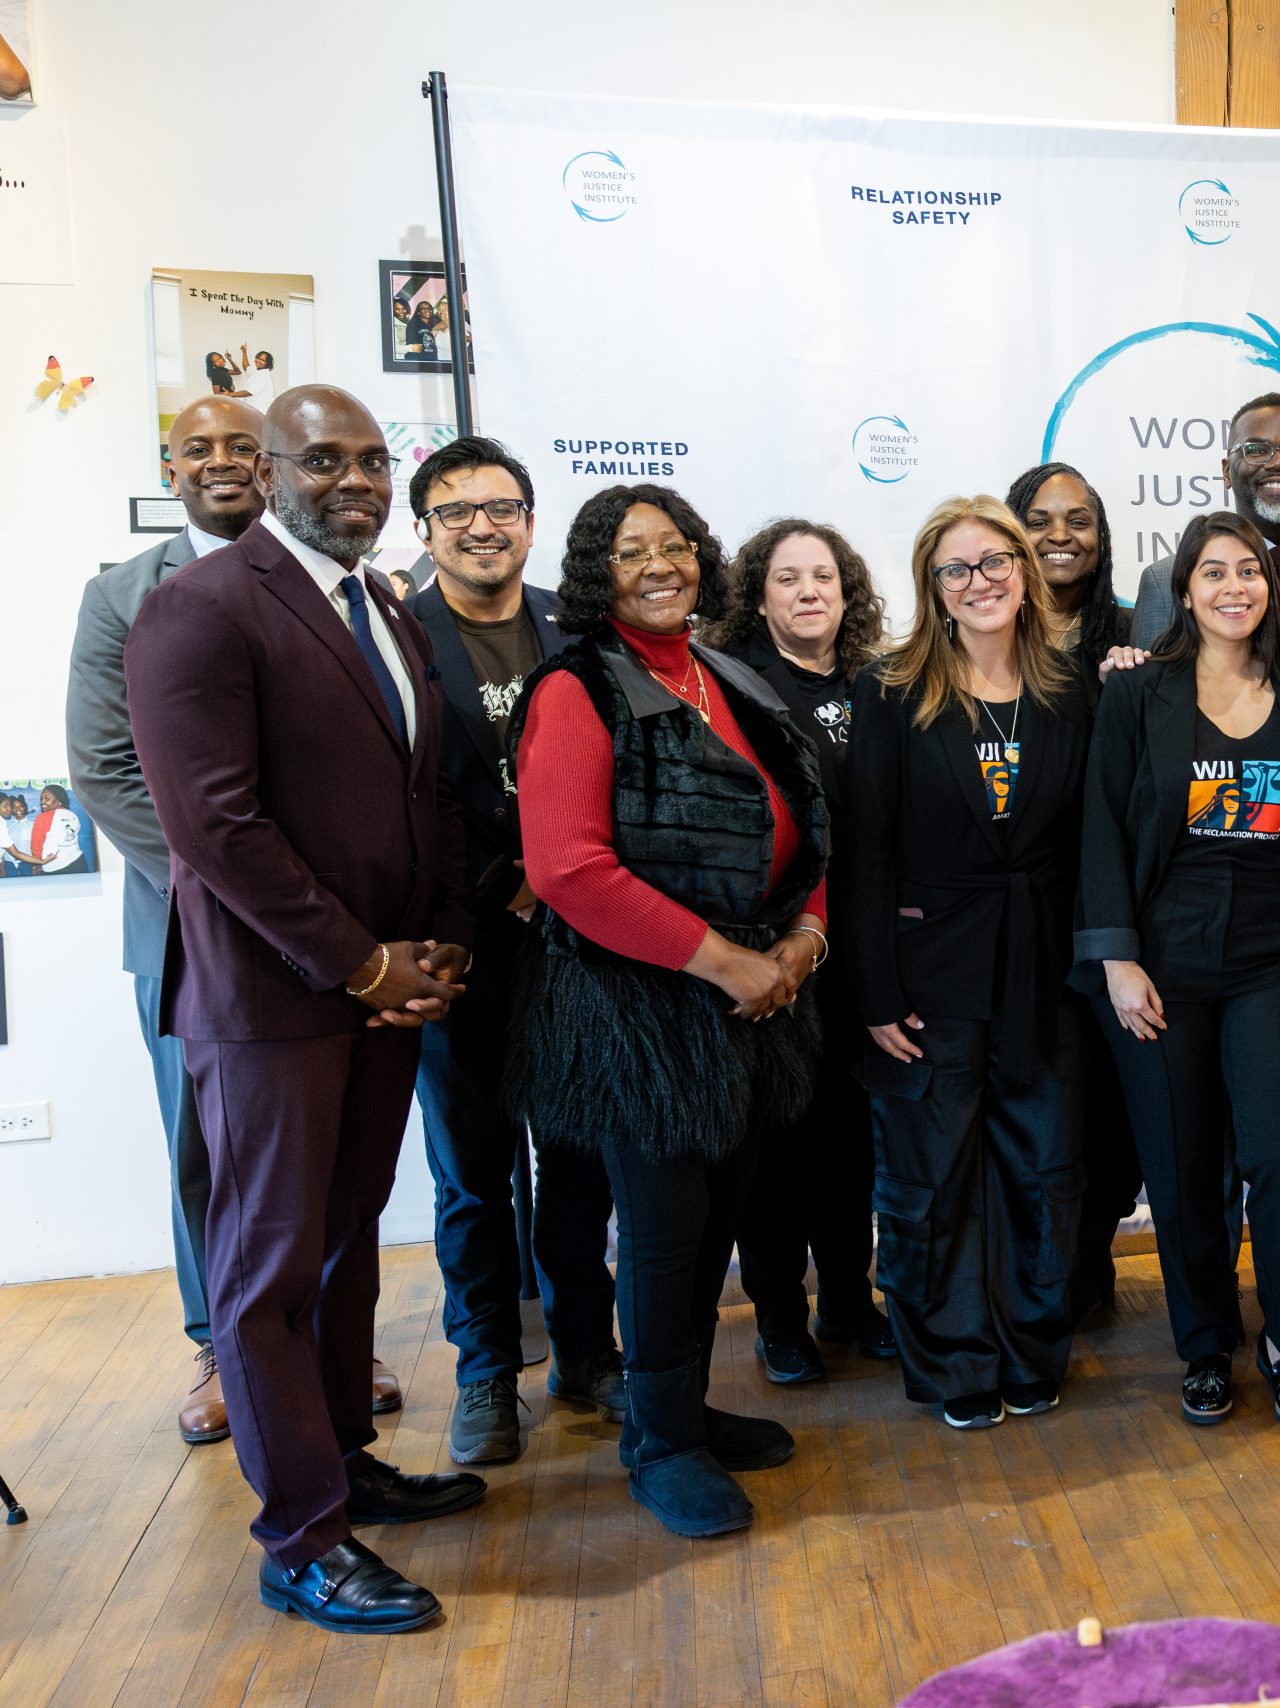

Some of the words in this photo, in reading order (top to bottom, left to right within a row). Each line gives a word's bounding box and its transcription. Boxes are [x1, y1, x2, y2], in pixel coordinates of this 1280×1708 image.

[581, 170, 636, 181] WOMEN'S
[583, 182, 623, 192] JUSTICE
[584, 194, 637, 204] INSTITUTE
[851, 185, 1002, 206] RELATIONSHIP
[1193, 197, 1240, 207] WOMEN'S
[892, 210, 971, 225] SAFETY
[1194, 209, 1229, 217] JUSTICE
[1195, 219, 1241, 229] INSTITUTE
[189, 288, 198, 297] I
[201, 289, 228, 302] Spent
[247, 295, 263, 310] Day
[869, 433, 919, 444] WOMEN'S
[553, 438, 689, 456] SUPPORTED
[870, 445, 907, 455] JUSTICE
[870, 456, 919, 466] INSTITUTE
[572, 460, 675, 476] FAMILIES
[1131, 474, 1229, 507] JUST
[1192, 760, 1234, 780] WJI
[1188, 827, 1202, 835] THE
[1203, 828, 1252, 839] RECLAMATION
